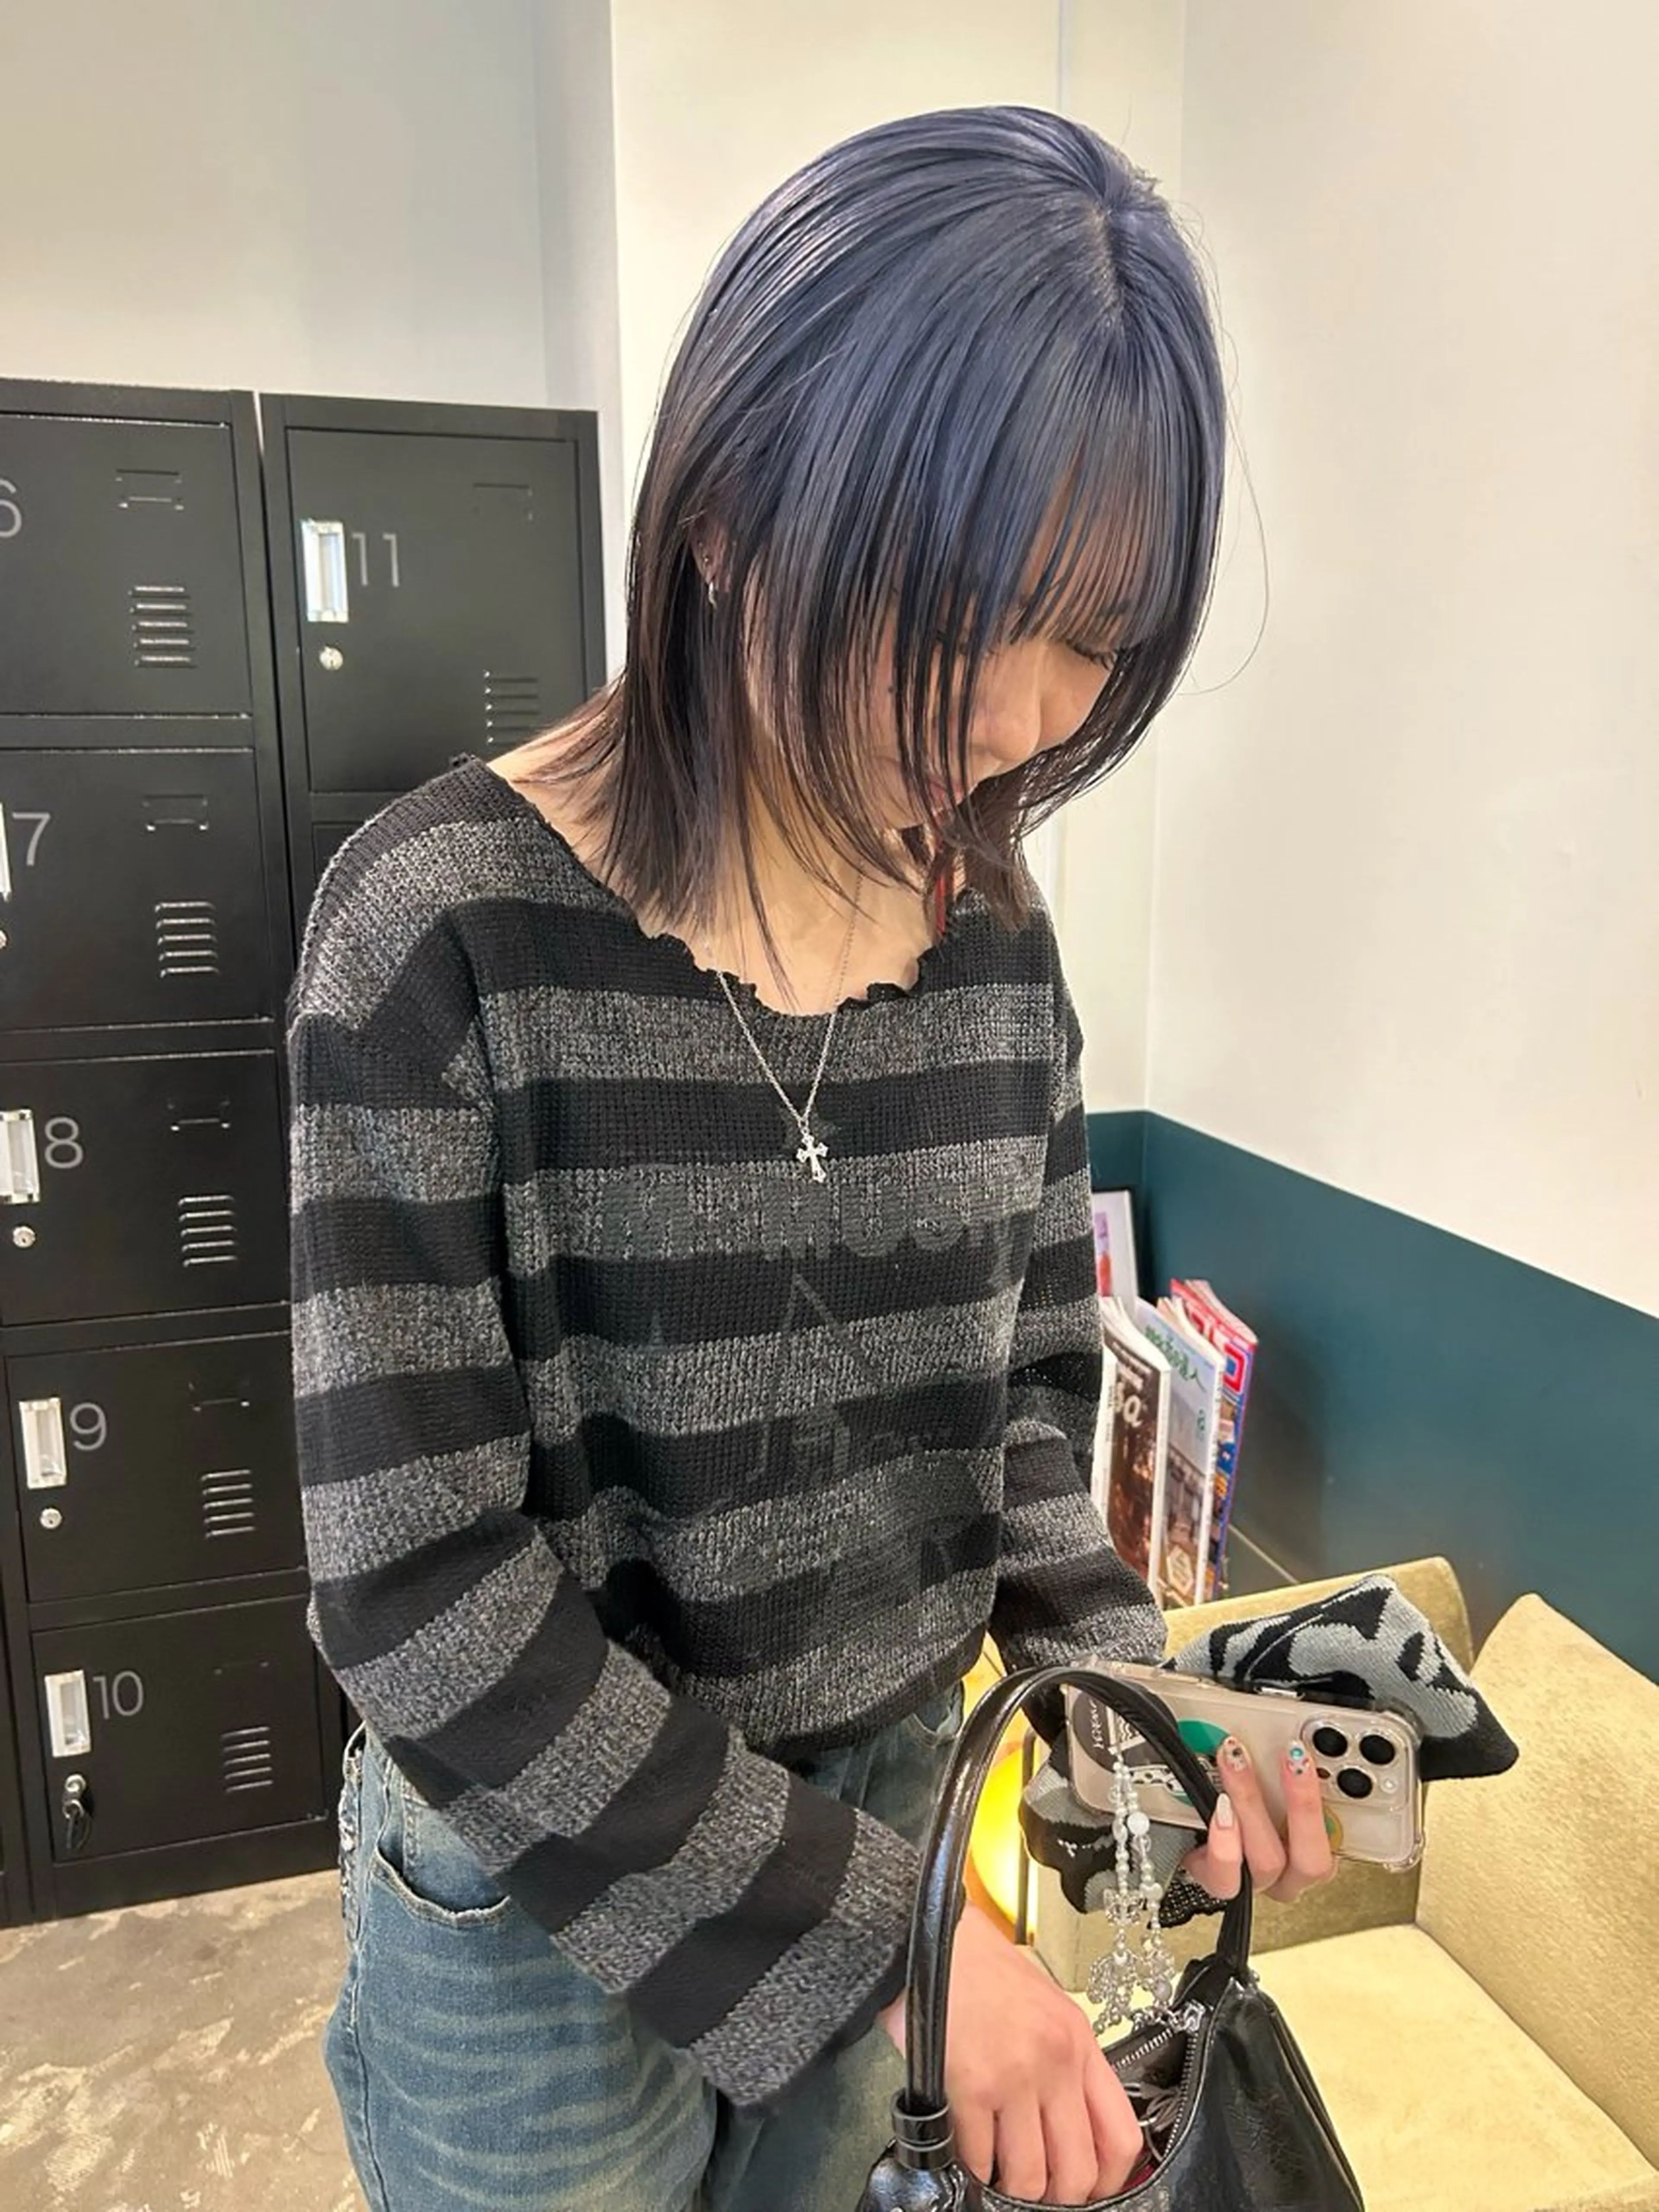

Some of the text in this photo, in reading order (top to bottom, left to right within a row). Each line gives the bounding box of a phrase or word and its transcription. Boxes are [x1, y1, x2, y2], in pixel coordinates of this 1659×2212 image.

[352, 532, 400, 588] 11
[12, 812, 51, 866] 7
[44, 1117, 83, 1169] 8
[69, 1402, 107, 1451] 9
[92, 1671, 143, 1719] 10
